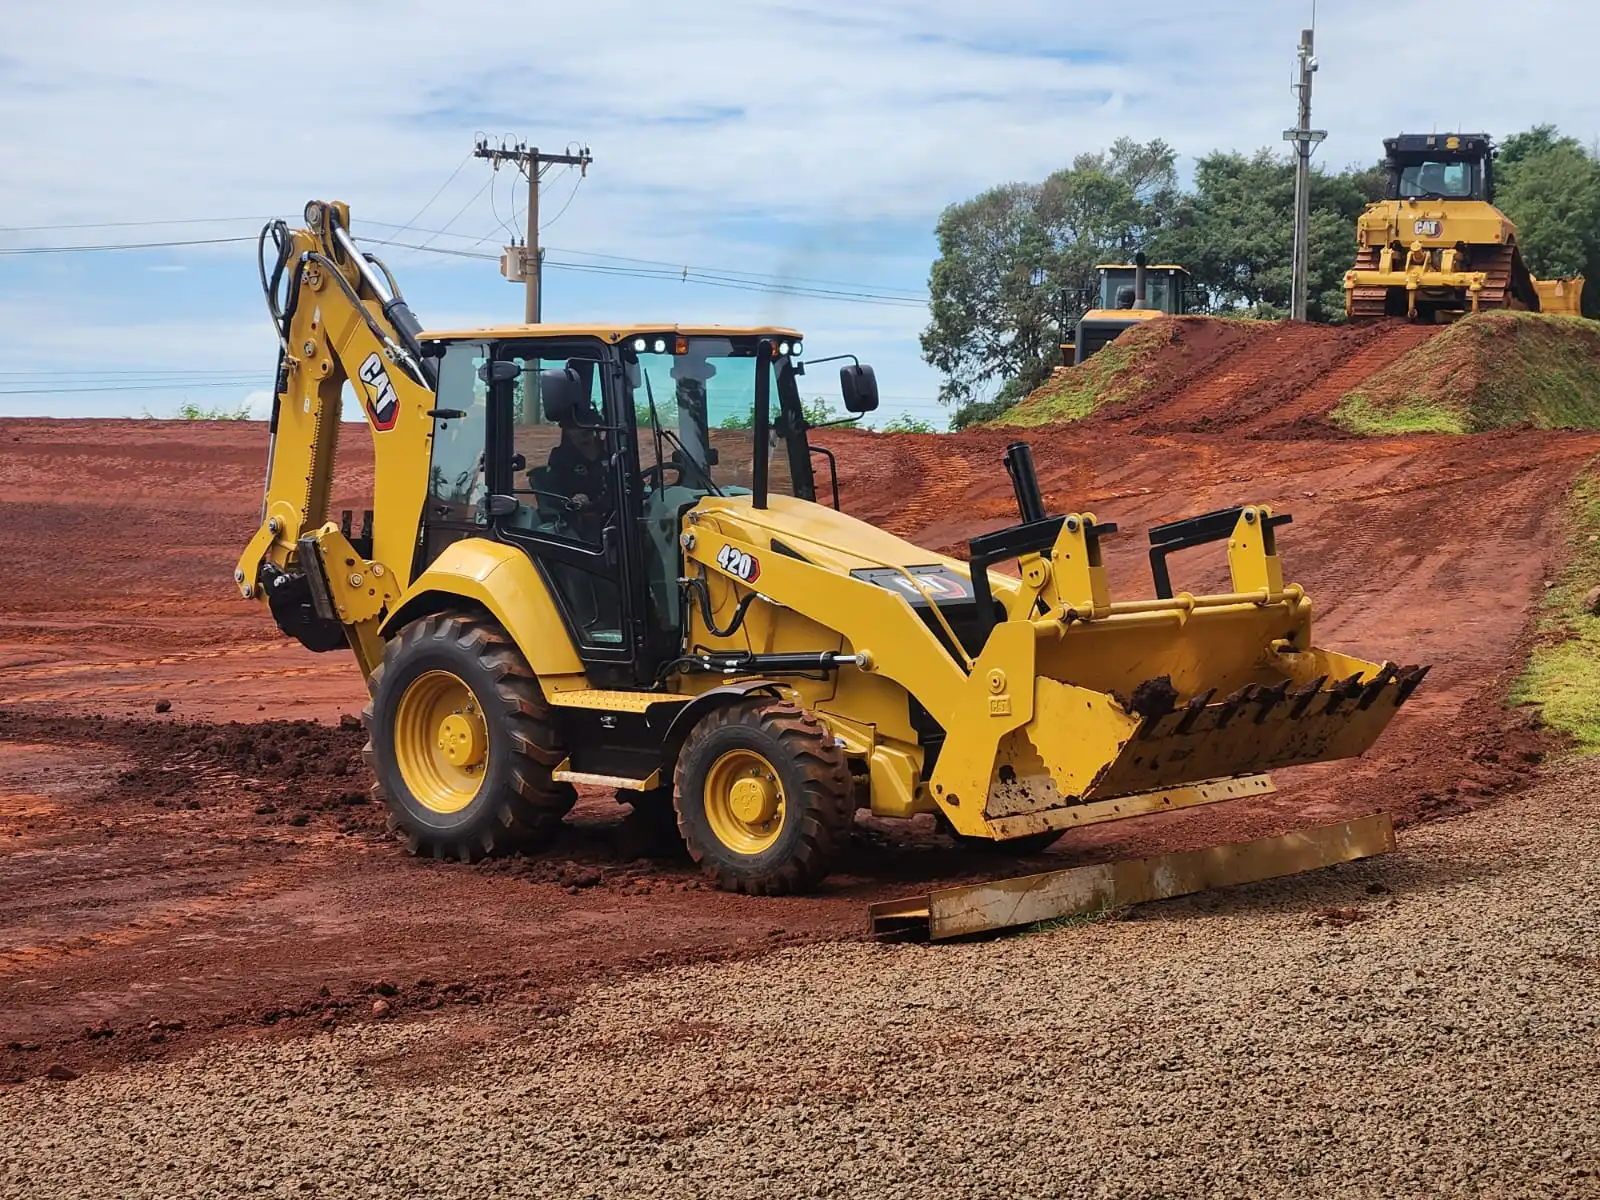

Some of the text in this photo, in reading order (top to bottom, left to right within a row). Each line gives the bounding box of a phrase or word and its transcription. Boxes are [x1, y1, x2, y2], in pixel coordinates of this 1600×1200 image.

[1414, 220, 1438, 235] CAT
[359, 352, 398, 415] CAT
[717, 544, 752, 579] 420
